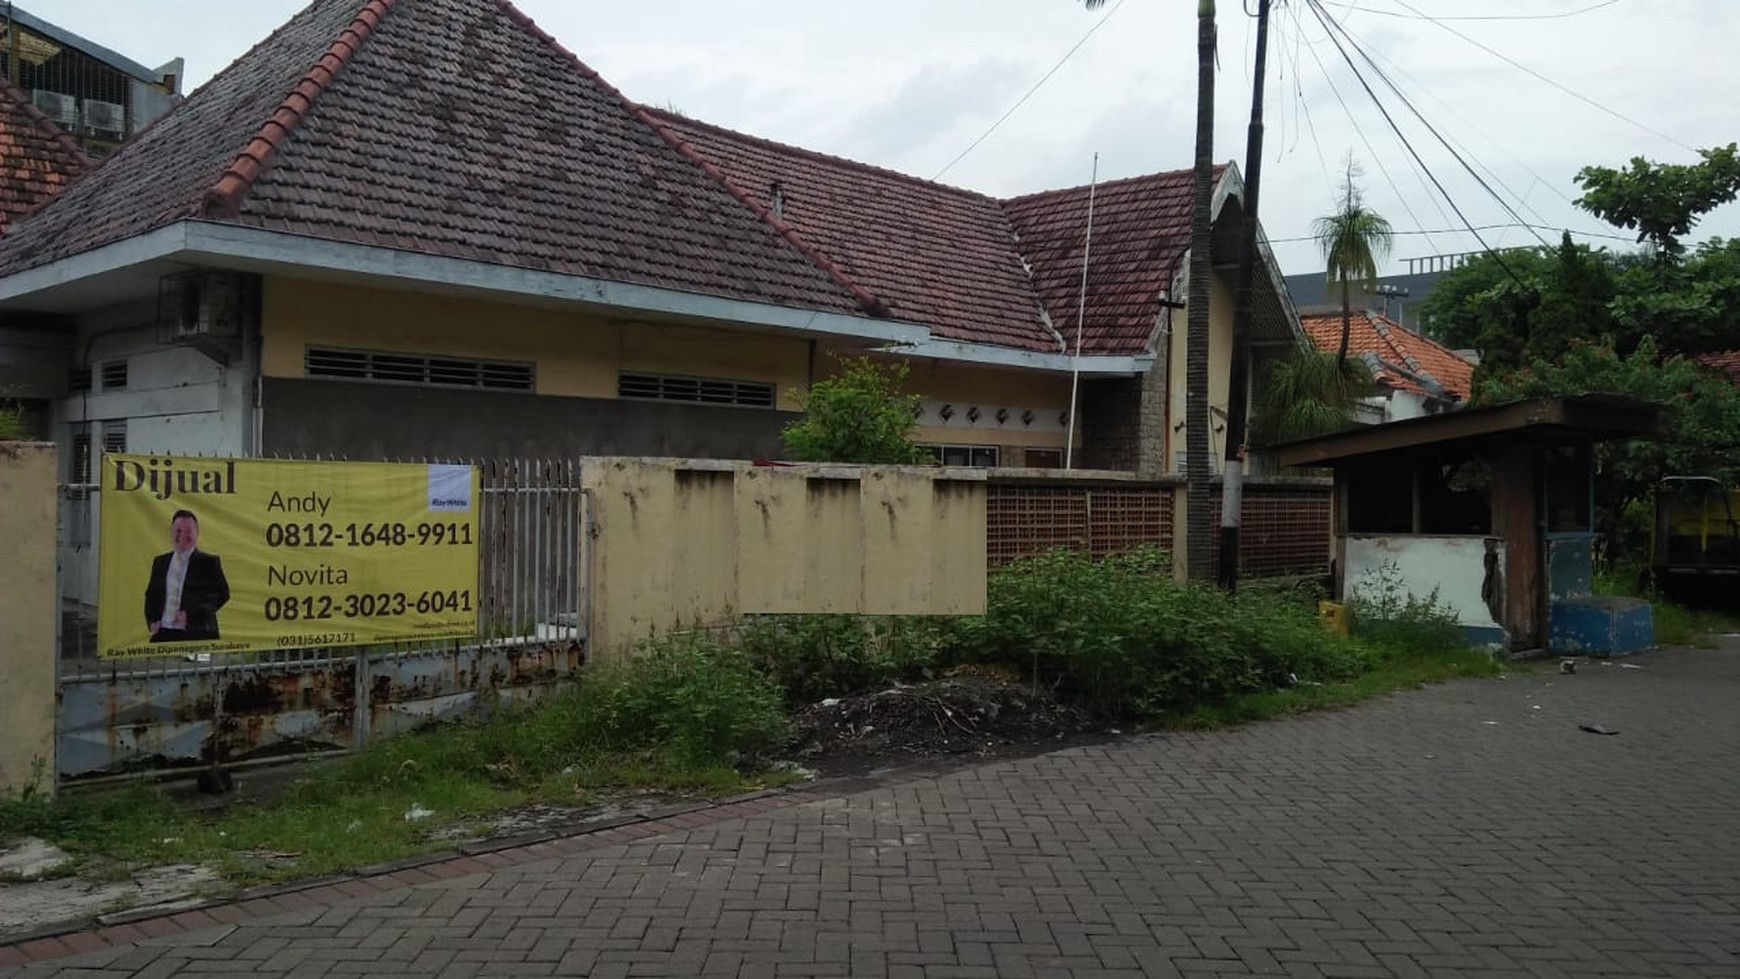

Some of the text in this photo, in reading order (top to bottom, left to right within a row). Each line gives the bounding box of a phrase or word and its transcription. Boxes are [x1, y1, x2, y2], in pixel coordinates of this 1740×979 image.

[114, 459, 236, 500] Dijual
[268, 491, 331, 516] Andy
[266, 523, 473, 547] 0812-1648-9911
[268, 565, 348, 586] Novita
[265, 591, 473, 621] 0812-3023-6041
[127, 646, 156, 656] White
[276, 632, 356, 647] (031)5617171
